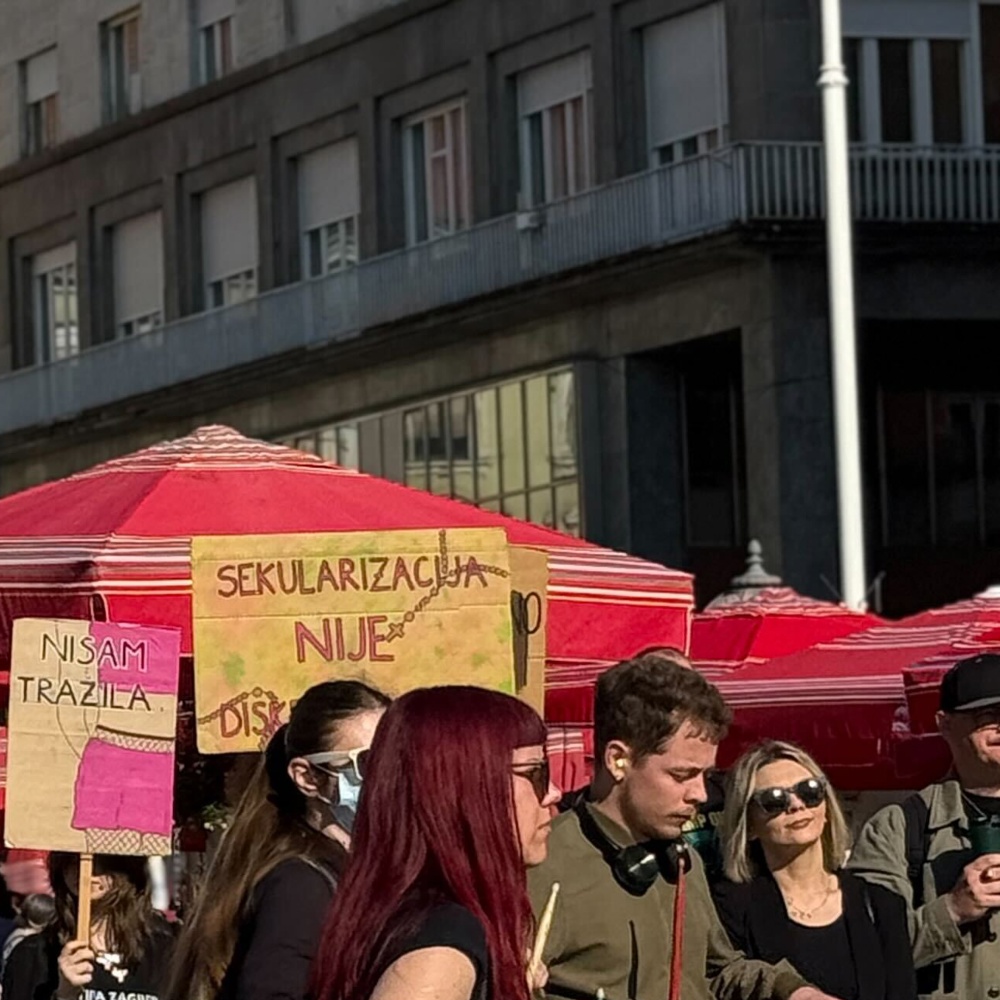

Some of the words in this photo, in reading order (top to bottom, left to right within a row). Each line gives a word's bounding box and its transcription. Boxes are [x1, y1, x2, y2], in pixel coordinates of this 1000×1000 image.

[217, 556, 488, 597] SEKULARIZACIJA
[42, 634, 145, 670] NISAM
[295, 615, 395, 663] NIJE
